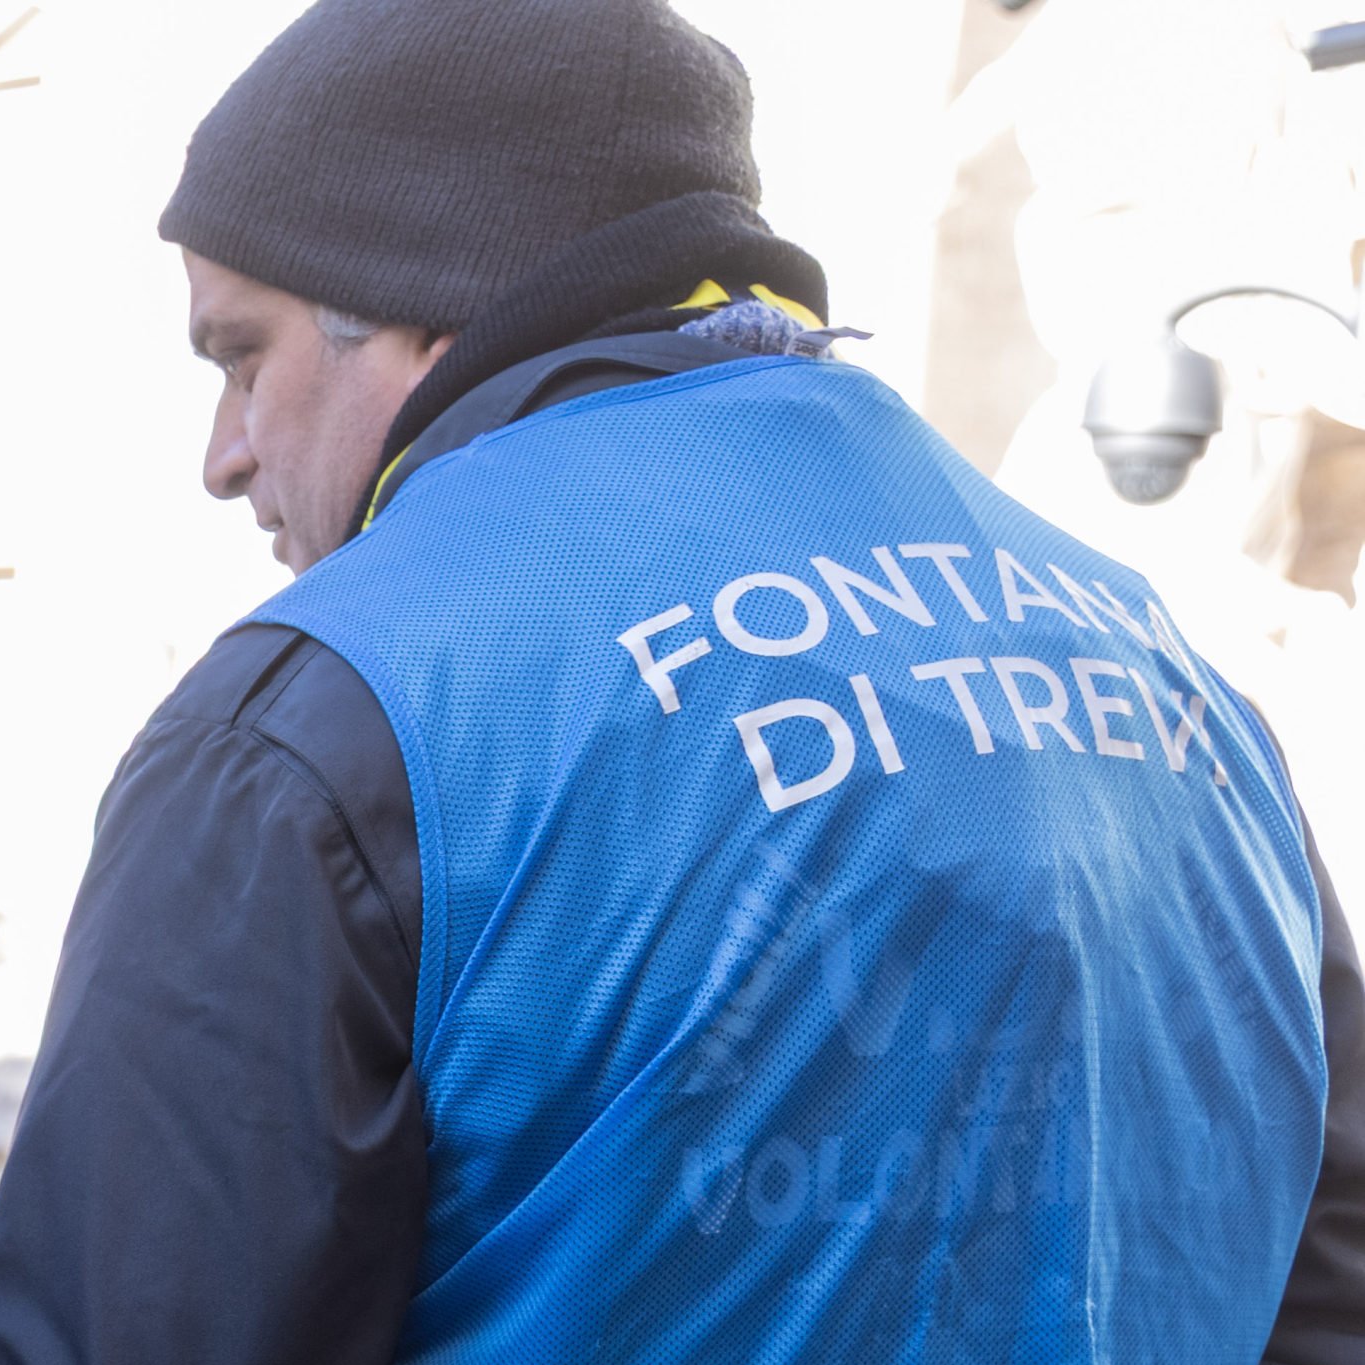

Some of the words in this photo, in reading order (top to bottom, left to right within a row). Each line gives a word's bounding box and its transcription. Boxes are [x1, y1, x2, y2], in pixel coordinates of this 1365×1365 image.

[616, 542, 1207, 715] FONTANA
[732, 673, 905, 813] DI
[910, 656, 1229, 787] TREVI
